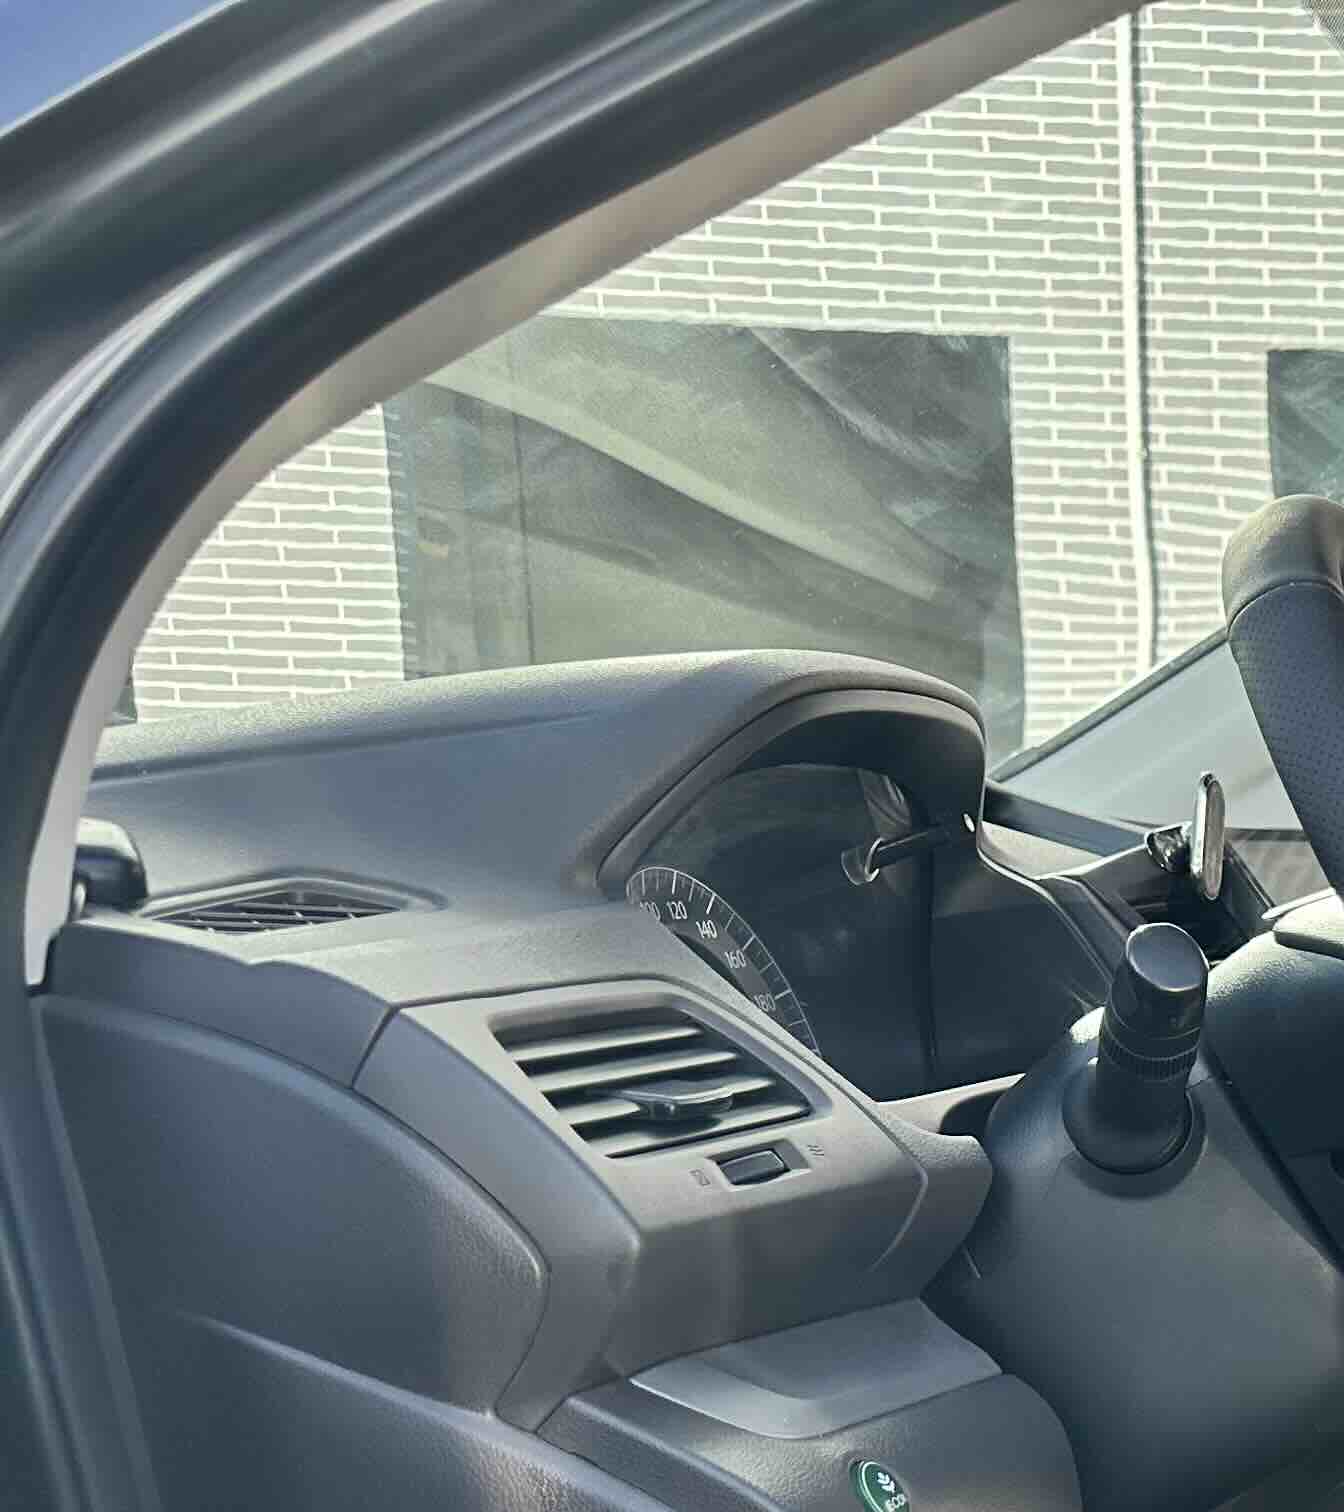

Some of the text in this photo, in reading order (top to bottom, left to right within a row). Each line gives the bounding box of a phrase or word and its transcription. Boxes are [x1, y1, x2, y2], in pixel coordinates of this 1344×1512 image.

[667, 902, 688, 920] 120
[696, 920, 718, 939] 140
[724, 951, 747, 969] 160
